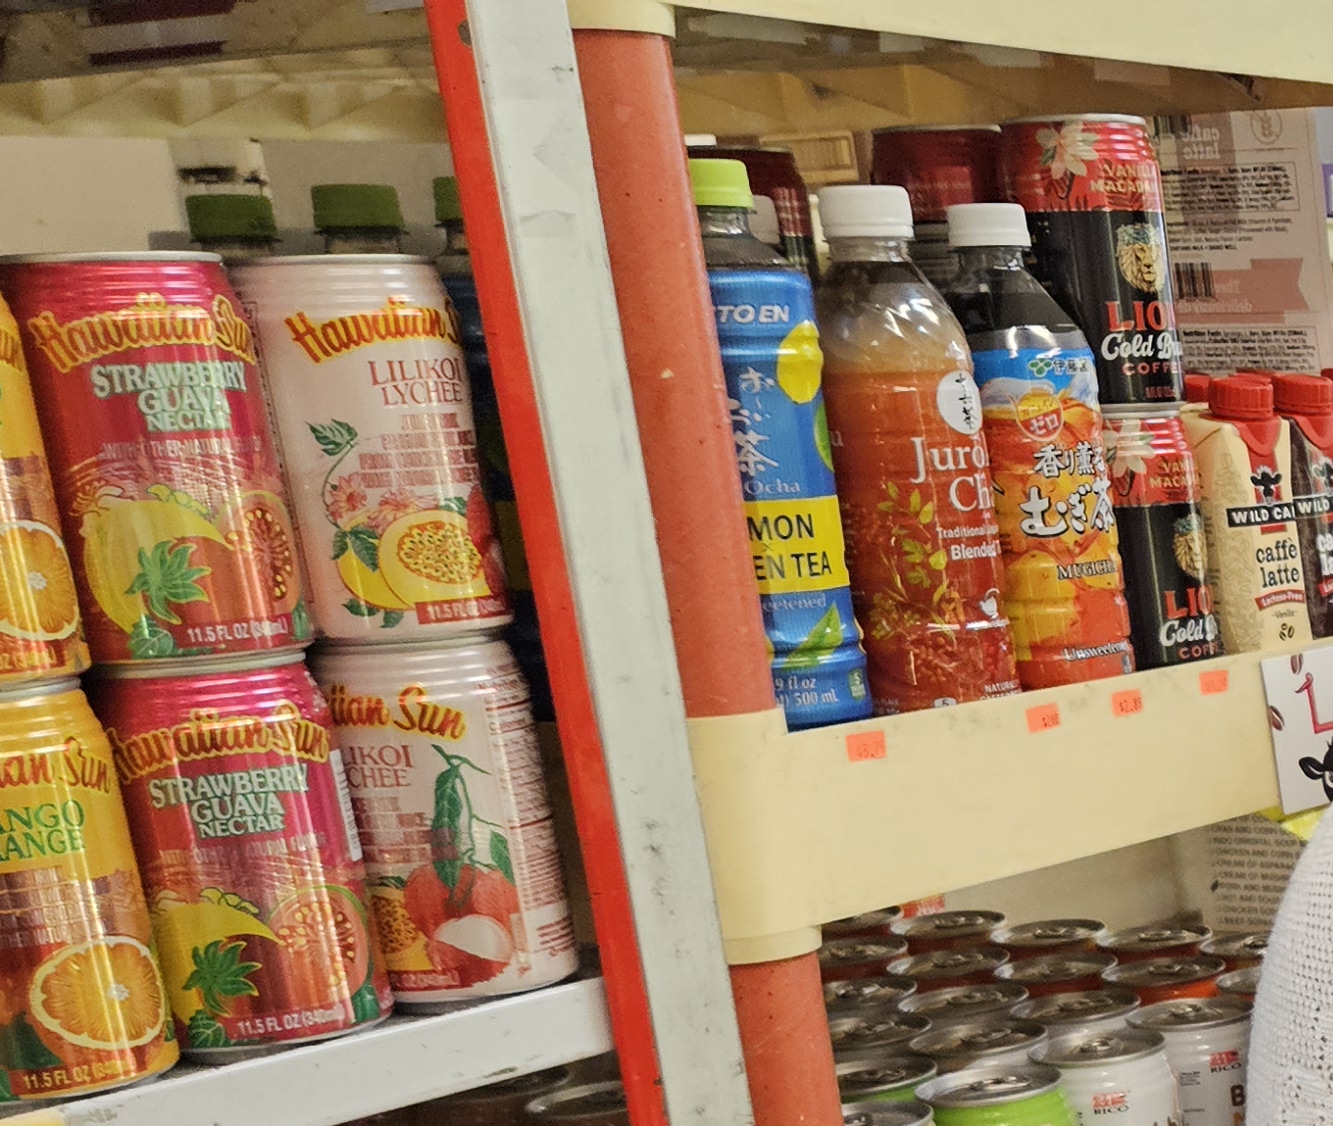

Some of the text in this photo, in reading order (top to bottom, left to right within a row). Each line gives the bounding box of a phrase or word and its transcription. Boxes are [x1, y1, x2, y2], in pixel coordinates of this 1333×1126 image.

[717, 304, 790, 324] TO EN
[1106, 300, 1172, 332] LIO
[27, 292, 216, 374] Hawaiian
[284, 296, 446, 364] Hawaiian
[1101, 332, 1154, 362] Cold
[91, 360, 248, 399] STRAWBERRY
[367, 357, 463, 387] LILIKOI
[1121, 361, 1183, 377] COFFE
[138, 384, 232, 416] GUAVA
[381, 381, 463, 406] LYCHEE
[146, 411, 232, 433] NECTAR
[1029, 412, 1060, 437] ゼロ
[911, 436, 991, 485] Juro
[744, 478, 801, 495] Ocha
[949, 474, 994, 513] Ch
[1019, 475, 1117, 539] むぎ茶
[1231, 510, 1270, 524] WILD
[1297, 497, 1330, 514] WILD
[747, 513, 815, 542] MON
[790, 550, 833, 578] TEA
[950, 542, 998, 561] Blended
[1256, 537, 1298, 564] caffè
[1260, 564, 1301, 589] latte
[1163, 585, 1214, 620] LIO
[186, 625, 216, 643] 11.5
[1159, 618, 1202, 648] Cold
[1062, 639, 1130, 662] Unsweetene
[394, 683, 467, 741] Sun
[267, 699, 330, 764] Sun
[59, 736, 111, 795] Sun
[149, 763, 309, 810] STRAWBERRY
[190, 793, 287, 824] GUAVA
[198, 814, 285, 839] NECTAR
[237, 1019, 265, 1036] 11.5
[265, 1017, 282, 1034] FL
[284, 1014, 302, 1030] OZ
[22, 1072, 53, 1090] 11.5
[53, 1068, 71, 1085] FL
[1209, 1063, 1242, 1074] RICO
[1093, 1105, 1130, 1115] RICO
